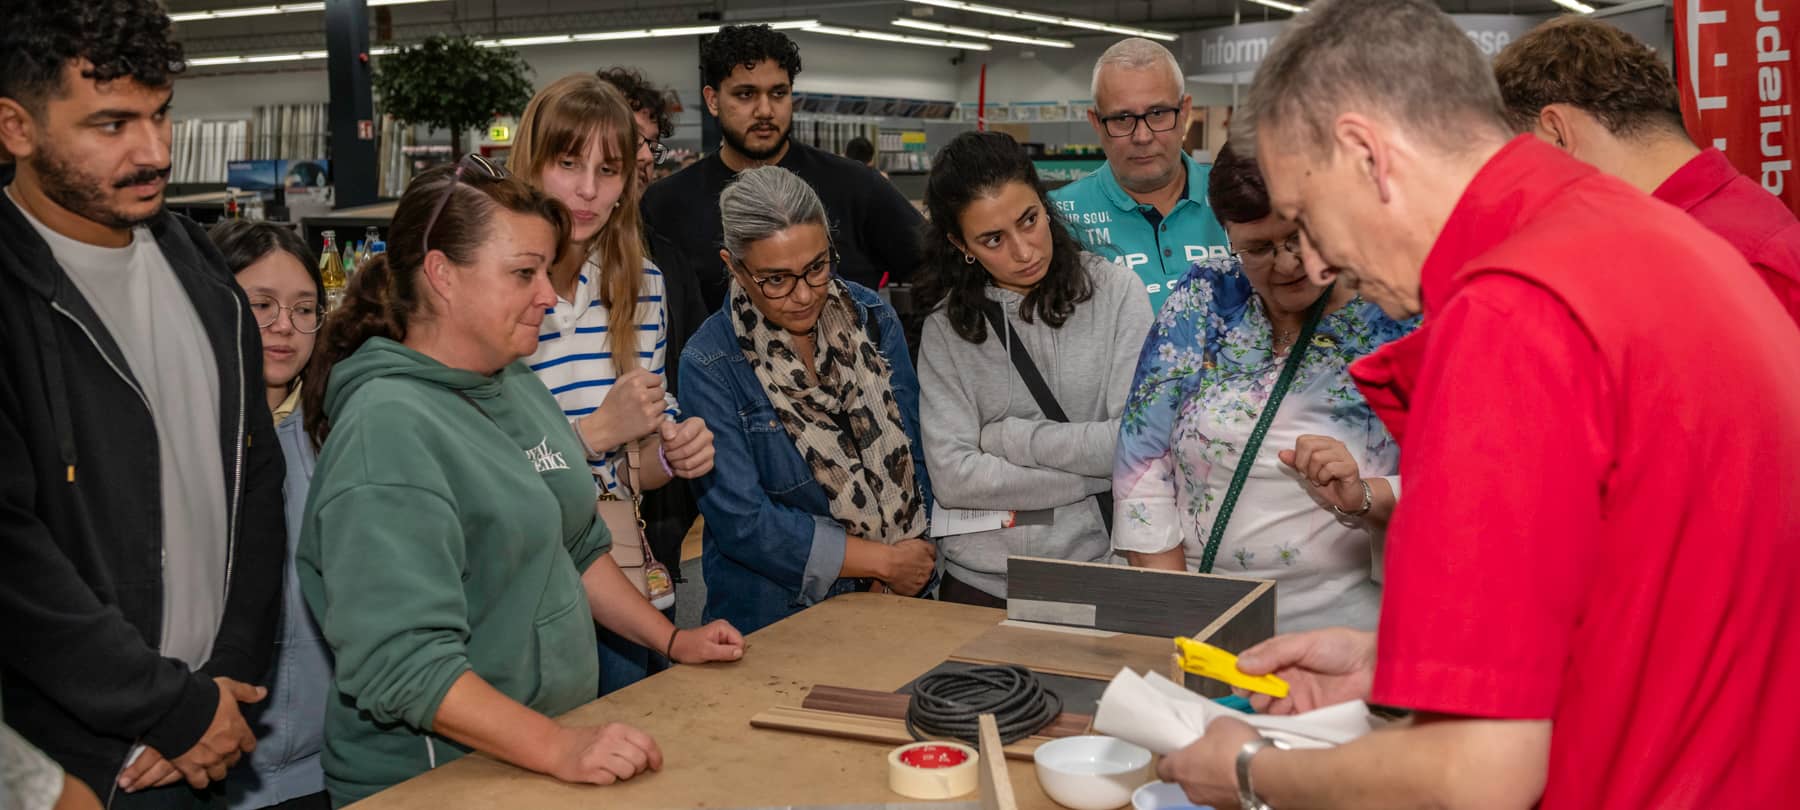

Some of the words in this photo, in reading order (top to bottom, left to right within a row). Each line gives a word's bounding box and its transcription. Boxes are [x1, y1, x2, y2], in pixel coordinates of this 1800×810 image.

[1201, 35, 1273, 65] Inform
[1084, 211, 1113, 224] SOUL
[1085, 227, 1112, 246] TM
[534, 451, 571, 473] ETICS
